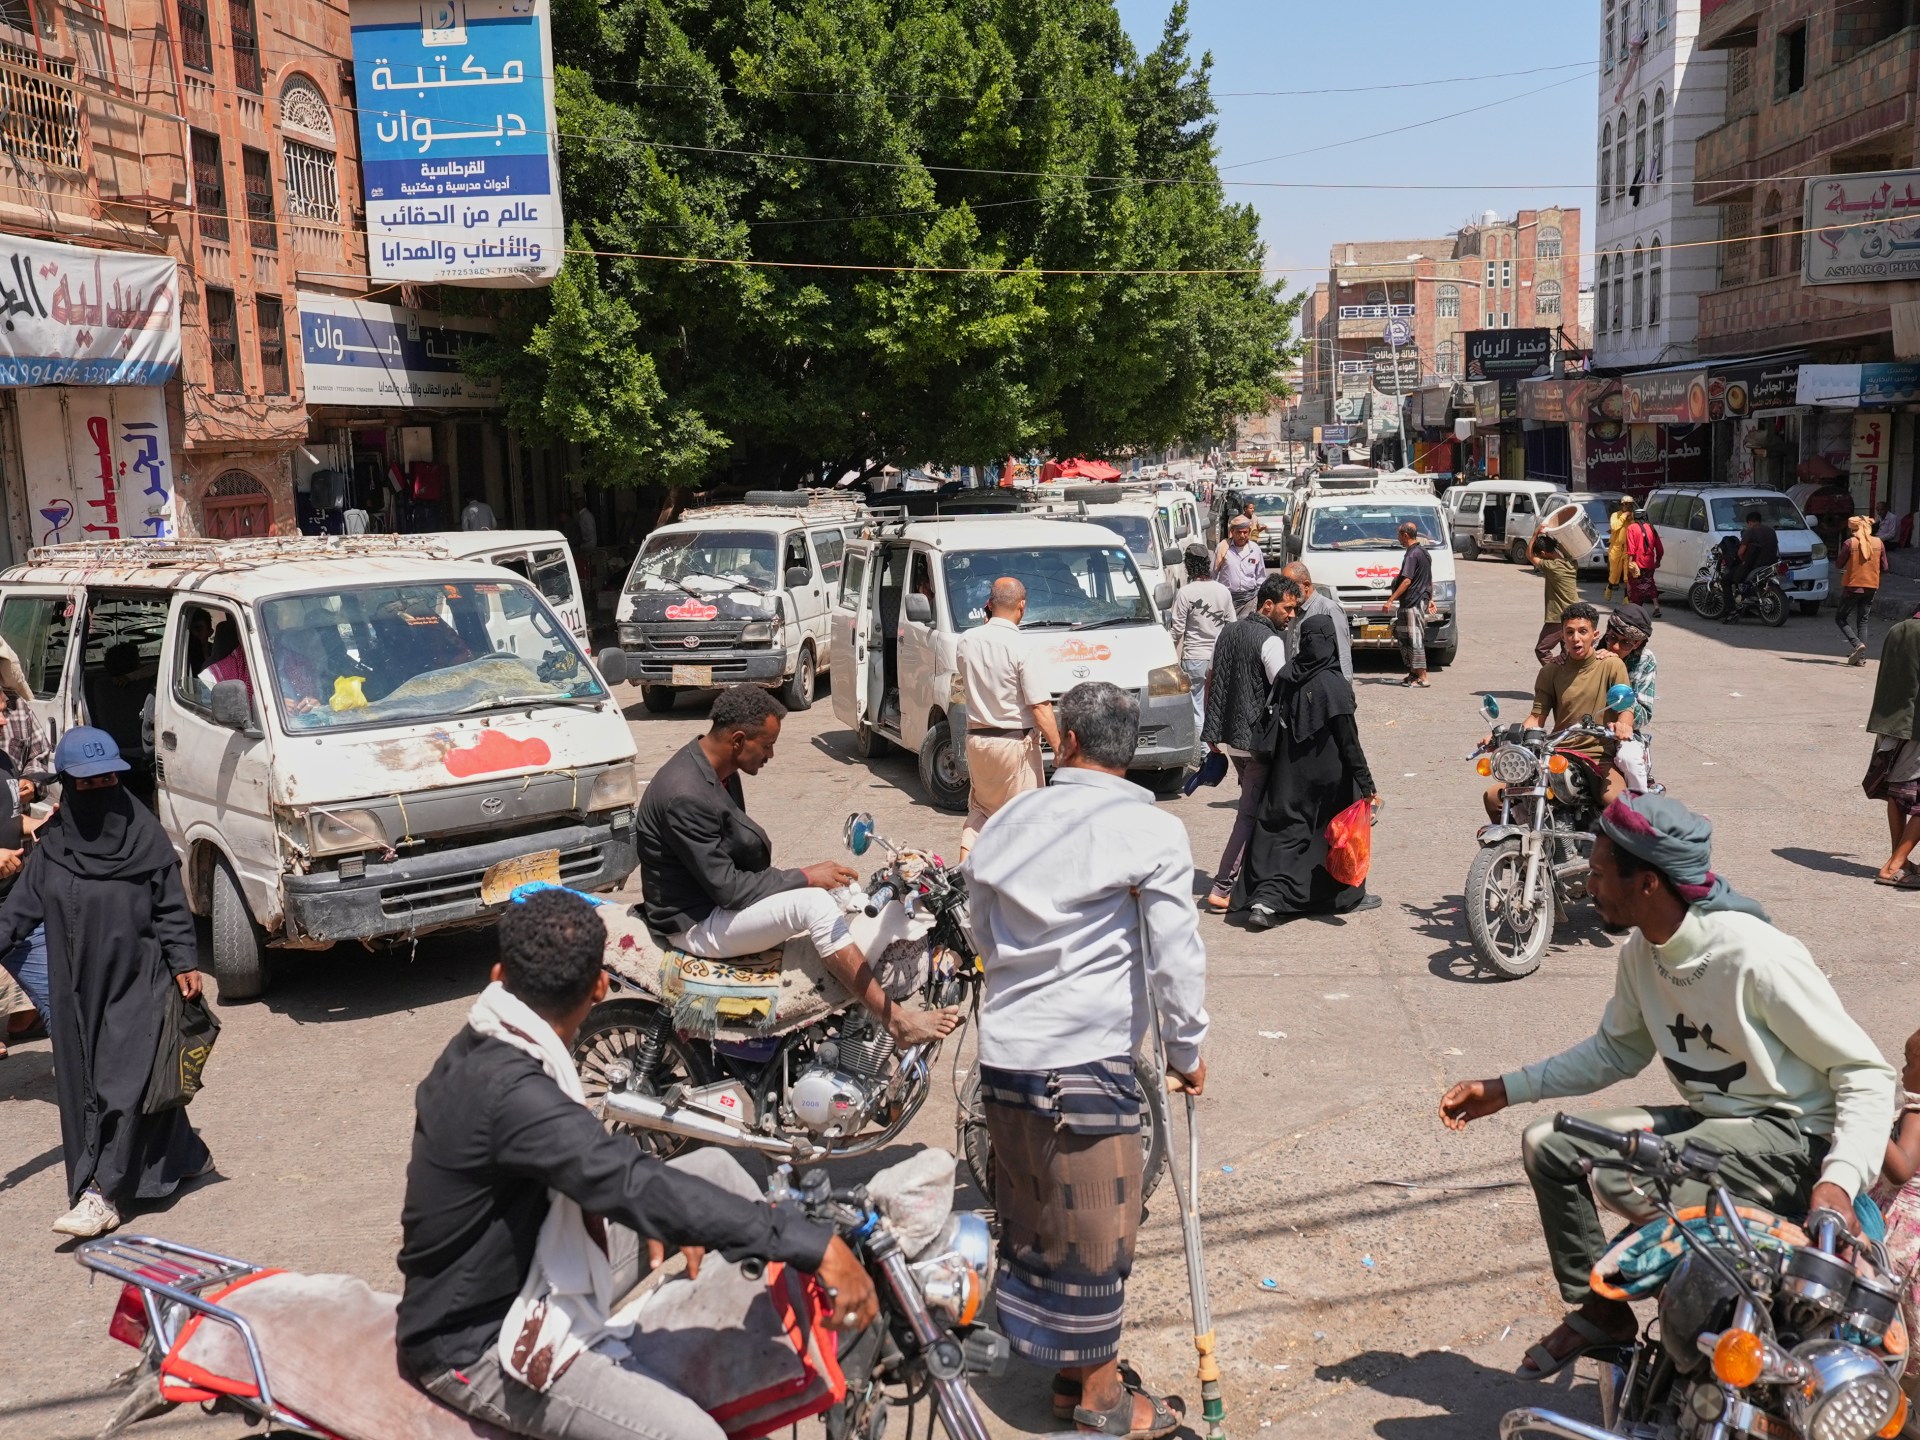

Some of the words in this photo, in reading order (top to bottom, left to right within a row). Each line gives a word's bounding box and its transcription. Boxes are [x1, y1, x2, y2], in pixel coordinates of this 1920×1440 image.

[371, 54, 523, 98] مكتبة
[421, 160, 485, 179] للقرطاسية
[401, 182, 434, 196] مكتبية
[437, 184, 443, 194] و
[446, 181, 481, 194] مدرسية
[484, 176, 510, 193] أدوات
[381, 205, 455, 231] الحقائب
[463, 206, 489, 228] من
[498, 202, 538, 227] عالم
[382, 241, 456, 267] والهدايا
[463, 236, 541, 264] والألعاب
[1825, 262, 1887, 277] ASHARQ
[1473, 339, 1510, 359] الريان
[1515, 339, 1547, 358] مخبز
[1587, 446, 1631, 470] الصنعاني
[1658, 442, 1701, 462] مطعم
[802, 1100, 820, 1108] 2008
